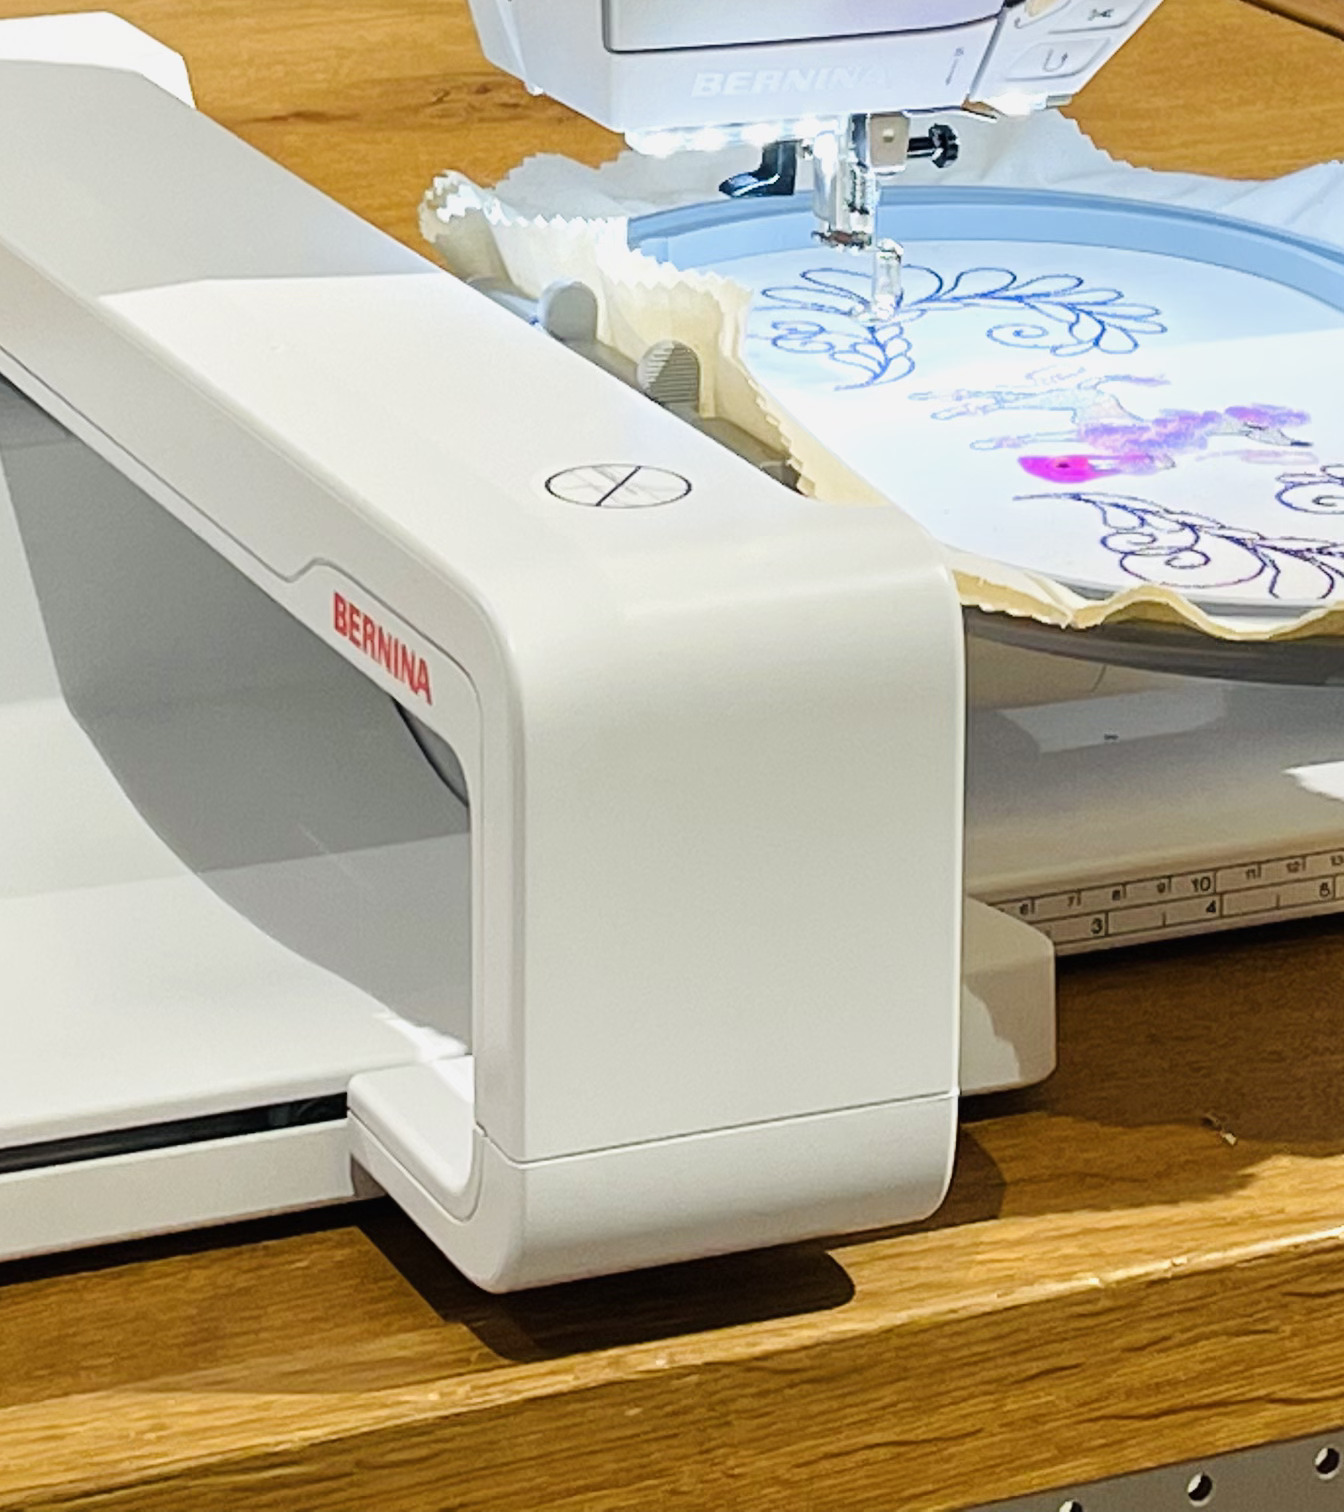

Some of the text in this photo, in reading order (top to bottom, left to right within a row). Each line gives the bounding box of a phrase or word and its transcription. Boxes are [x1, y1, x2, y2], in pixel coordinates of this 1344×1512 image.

[690, 66, 891, 97] BERNINA
[333, 591, 432, 706] BERNINA
[1191, 876, 1211, 893] 10
[1286, 861, 1301, 873] 12
[1330, 855, 1344, 867] 13
[1090, 917, 1103, 935] 3
[1205, 899, 1216, 914] 4
